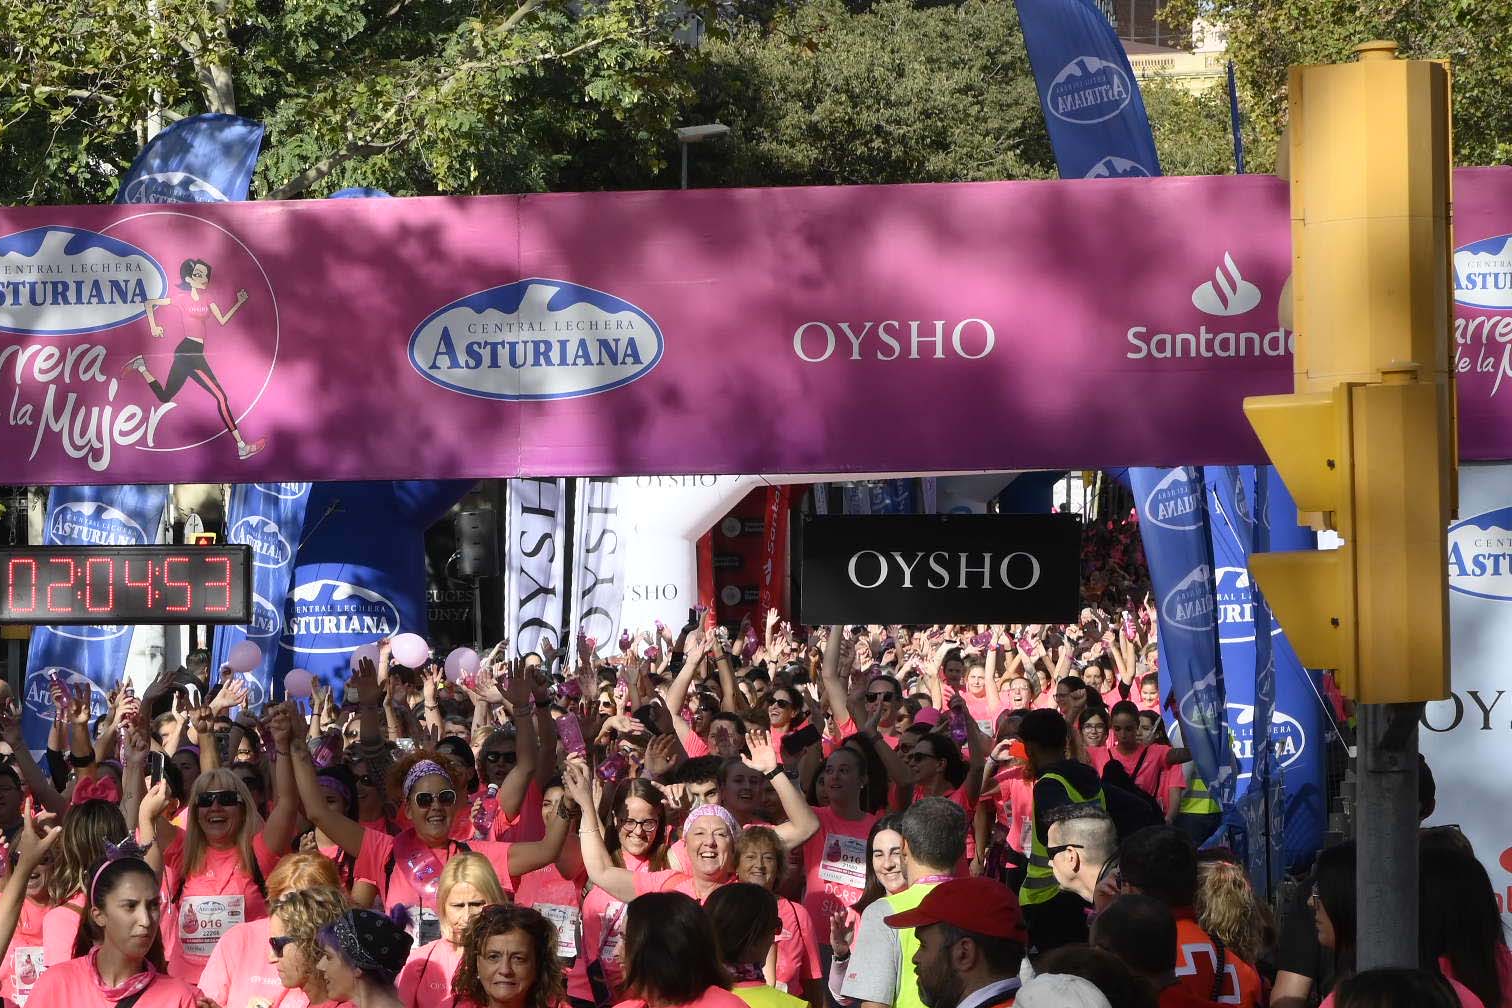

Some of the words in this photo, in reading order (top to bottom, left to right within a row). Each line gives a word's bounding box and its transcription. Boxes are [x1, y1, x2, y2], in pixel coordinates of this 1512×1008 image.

[70, 261, 143, 274] LECHERA
[467, 321, 546, 334] CENTRAL
[554, 319, 636, 332] LECHERA
[793, 318, 996, 363] OYSHO
[428, 326, 644, 371] ASTURIANA
[1477, 345, 1496, 373] la
[8, 395, 33, 425] la
[28, 375, 178, 471] Mujer
[8, 557, 231, 613] 02:04:53
[848, 550, 1041, 591] OYSHO
[200, 920, 222, 928] 016
